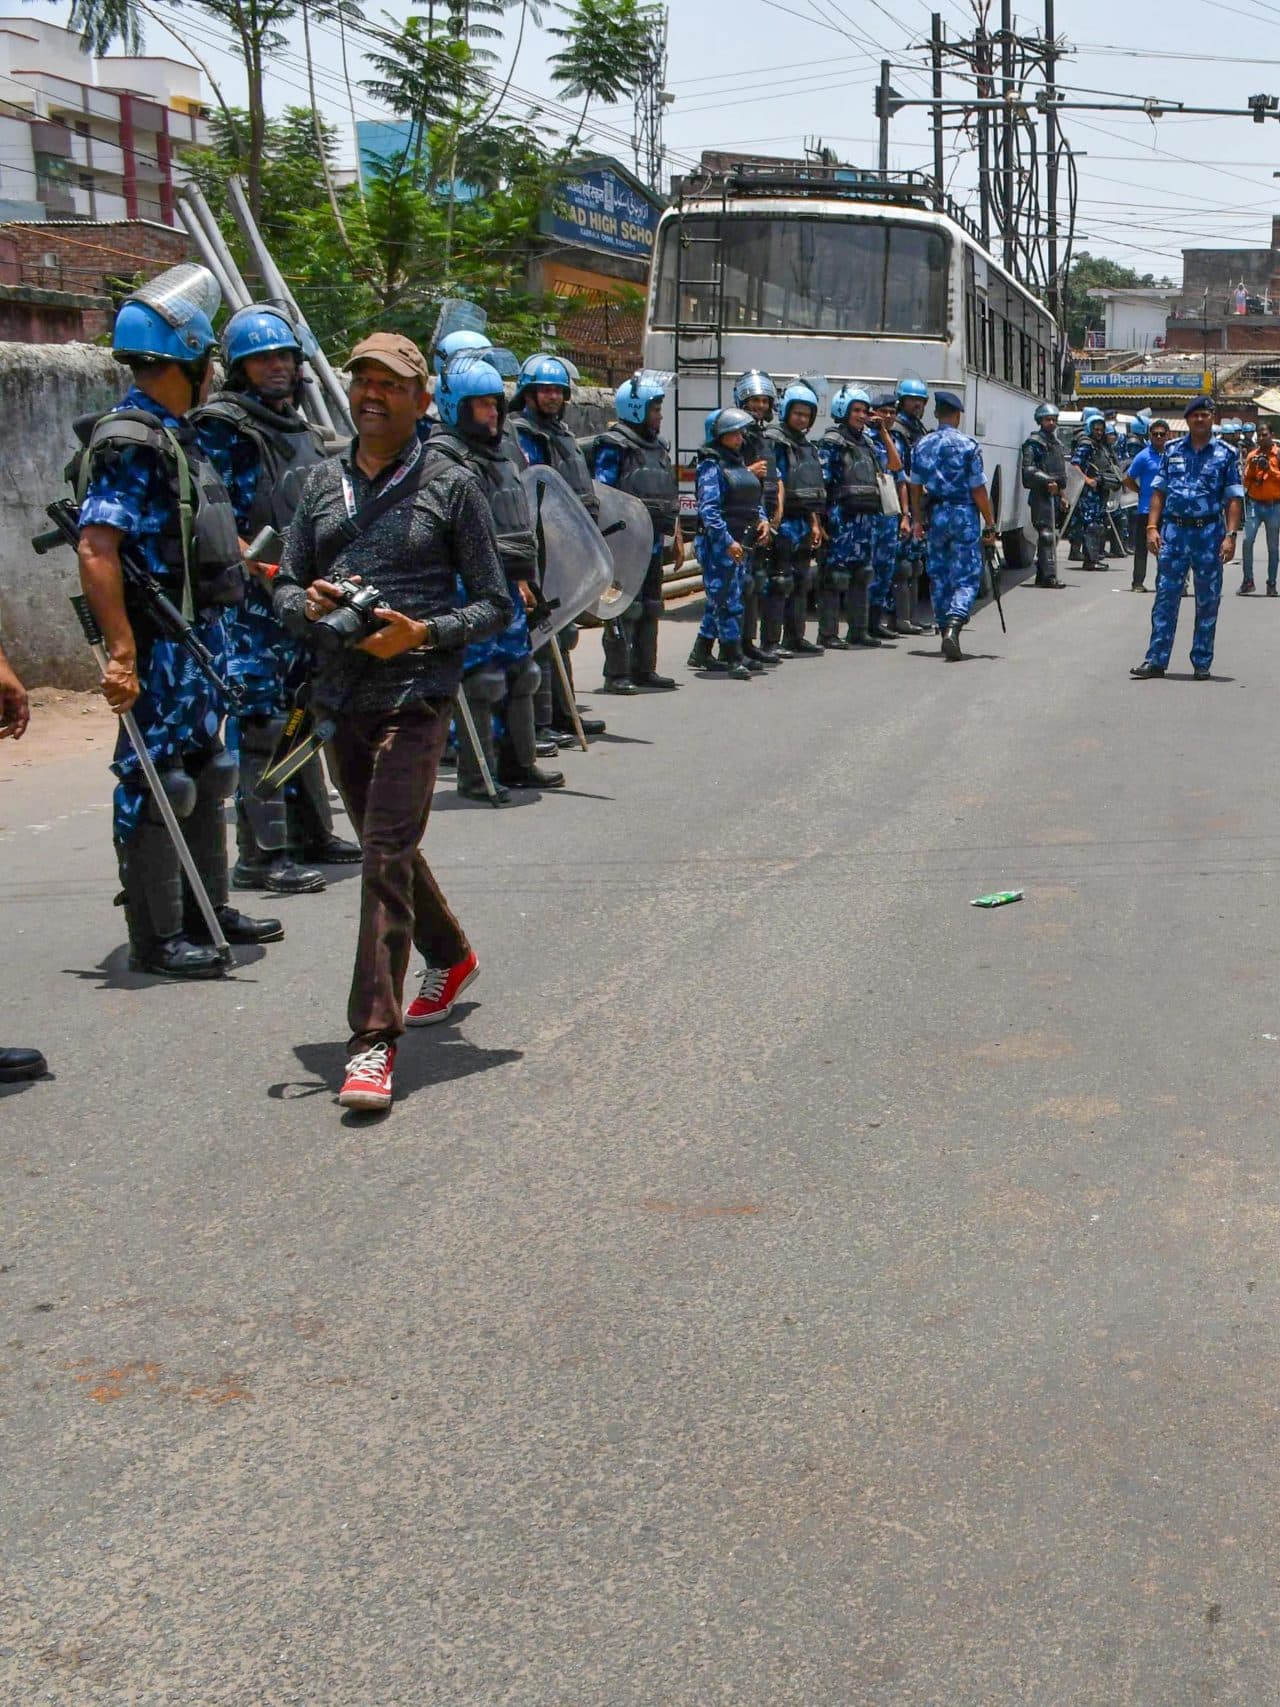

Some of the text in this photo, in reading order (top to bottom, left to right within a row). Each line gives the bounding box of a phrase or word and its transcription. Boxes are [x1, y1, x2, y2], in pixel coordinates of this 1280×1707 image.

[589, 211, 618, 235] HIGH
[620, 221, 655, 246] SCHO
[1080, 374, 1107, 384] जनता
